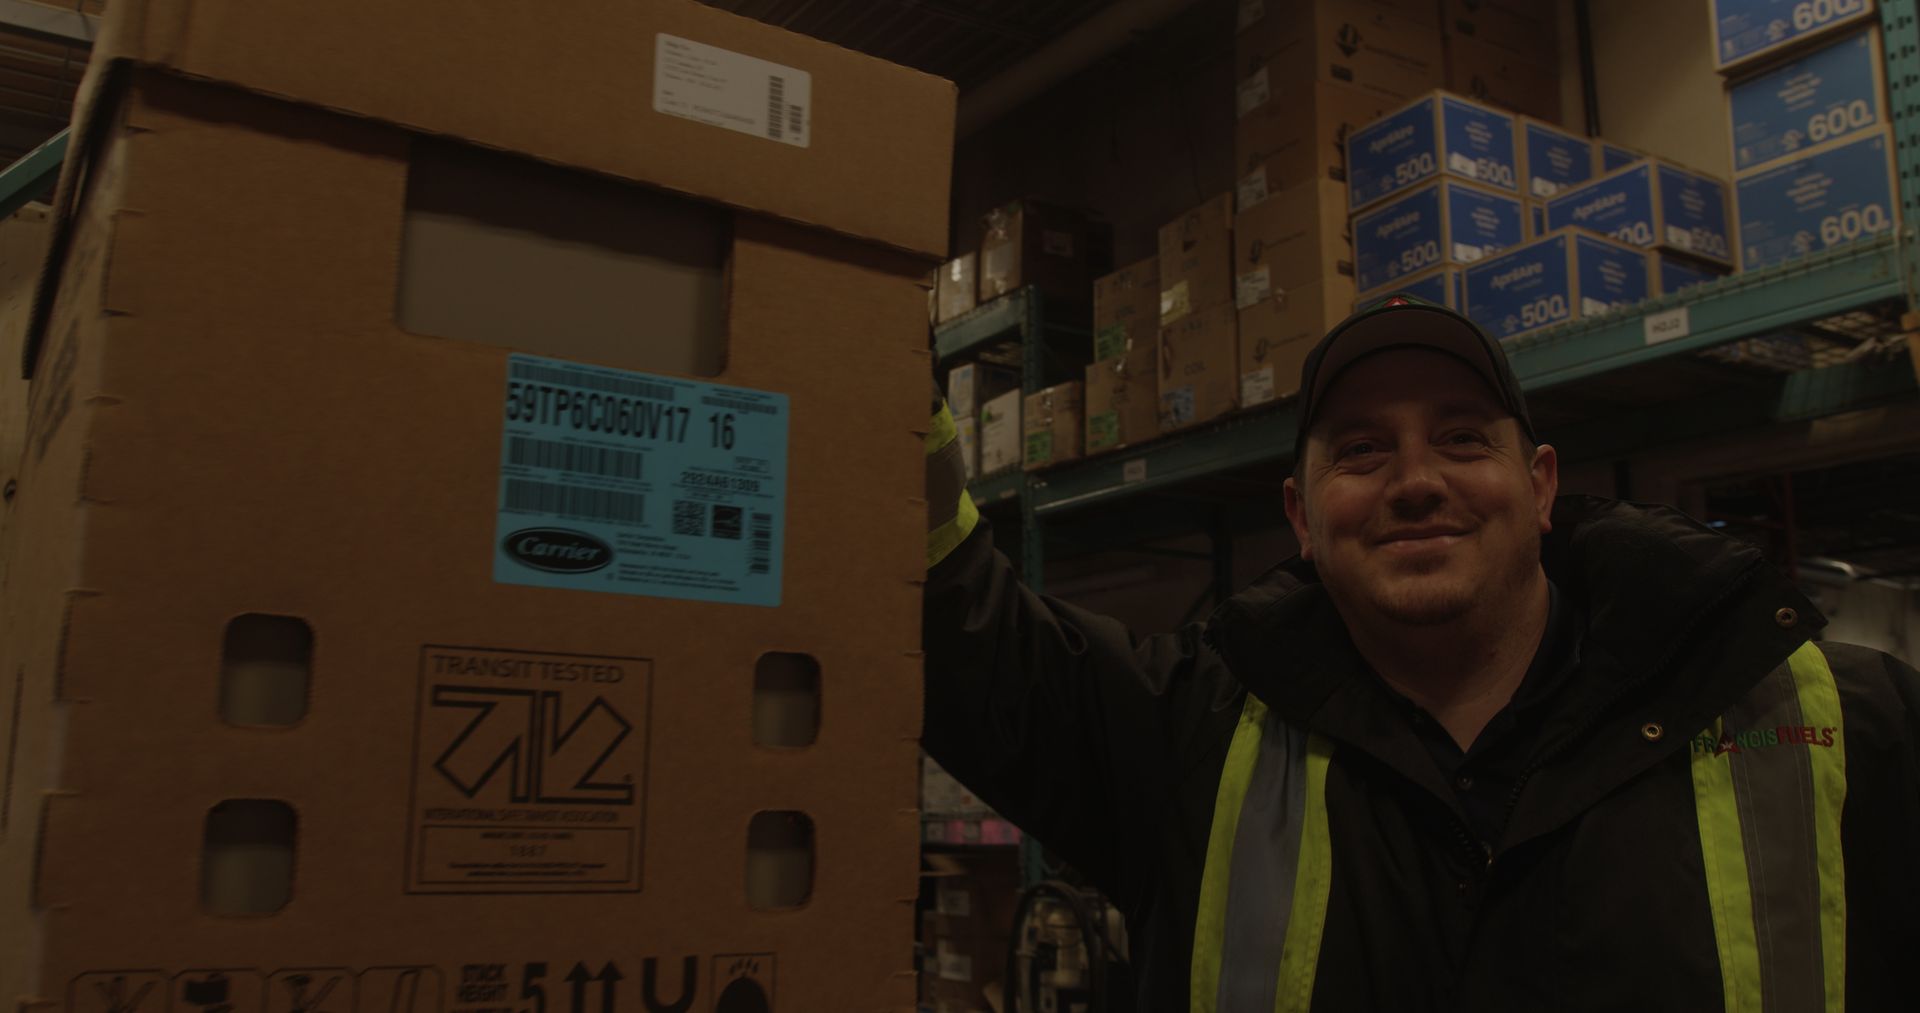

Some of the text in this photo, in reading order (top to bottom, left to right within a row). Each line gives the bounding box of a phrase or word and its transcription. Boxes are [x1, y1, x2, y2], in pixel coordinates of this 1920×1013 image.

[507, 382, 736, 451] 59TP6C060V17 16
[517, 536, 599, 562] Carrier
[432, 655, 624, 683] TRANSIT TESTED
